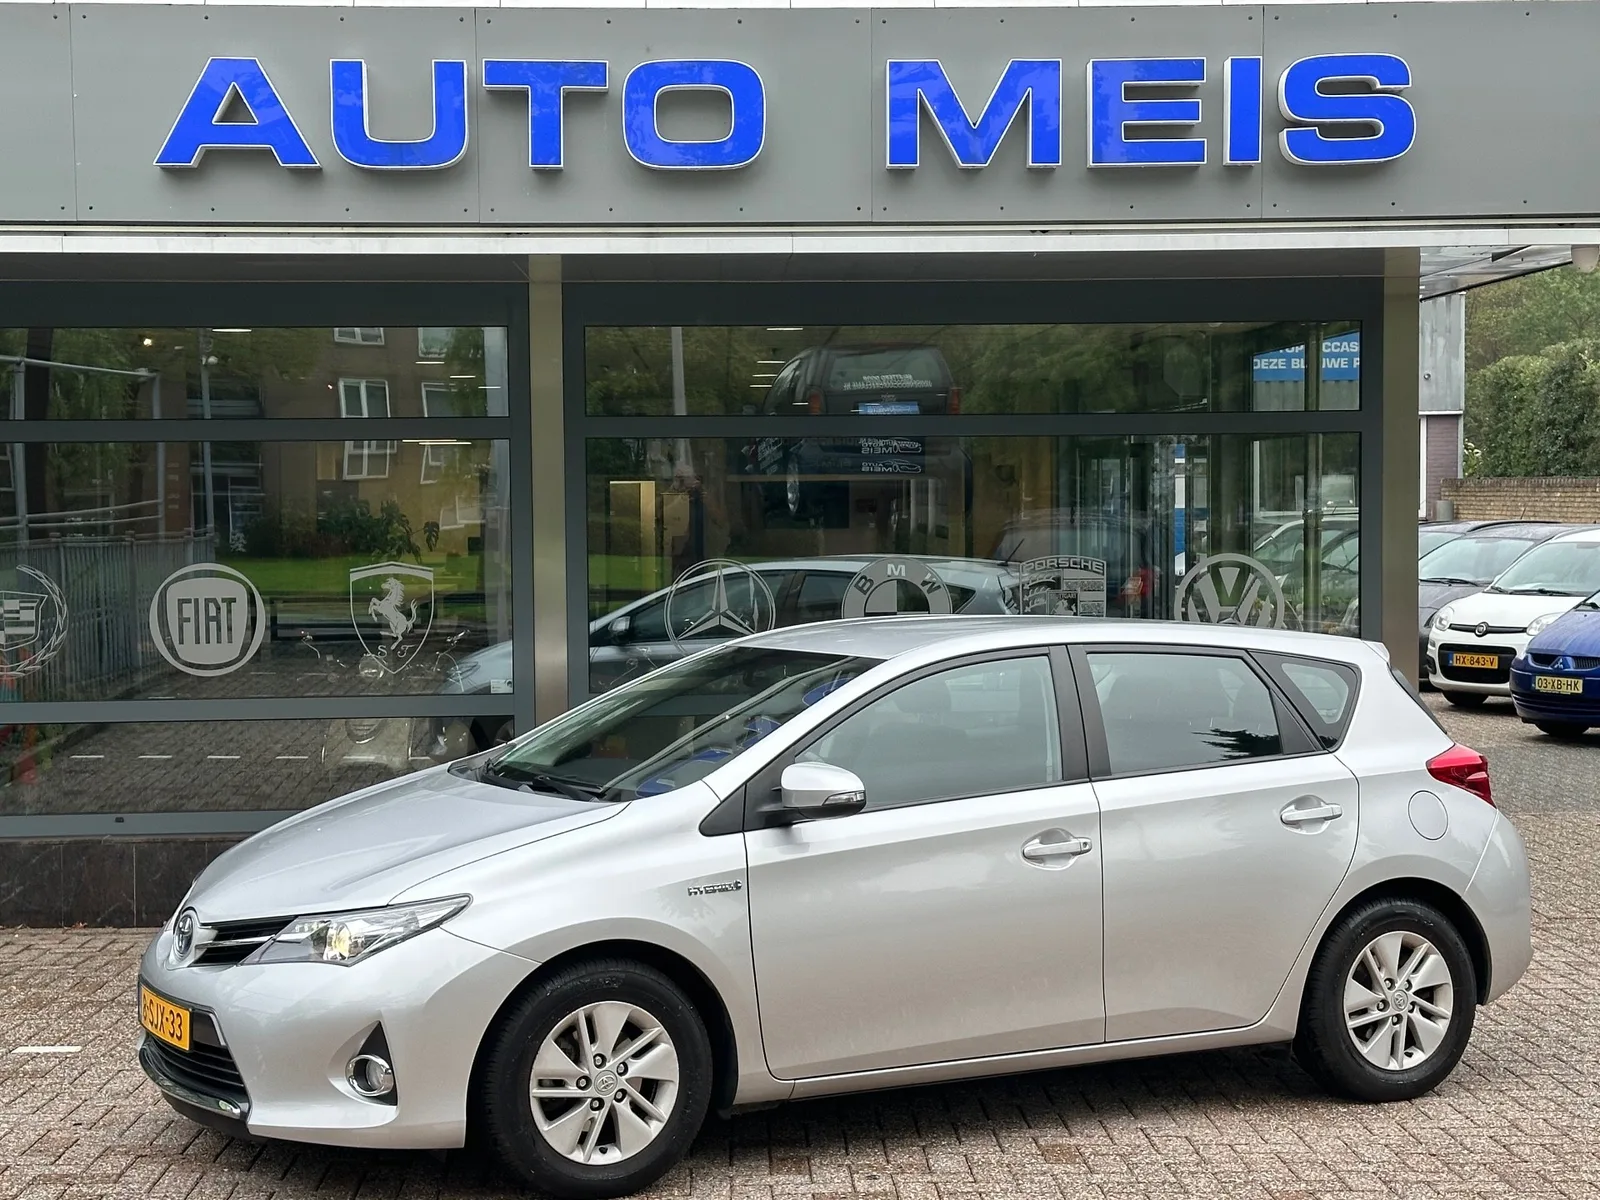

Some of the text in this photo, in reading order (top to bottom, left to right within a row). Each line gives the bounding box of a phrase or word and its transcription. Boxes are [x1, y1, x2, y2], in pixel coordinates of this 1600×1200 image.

[152, 52, 1417, 170] AUTO MEIS
[853, 563, 942, 596] BMW
[1021, 557, 1104, 576] PORSCHE
[177, 597, 237, 645] FIAT
[1454, 653, 1496, 667] HX-843-V
[1536, 676, 1580, 692] 03-XB-HK
